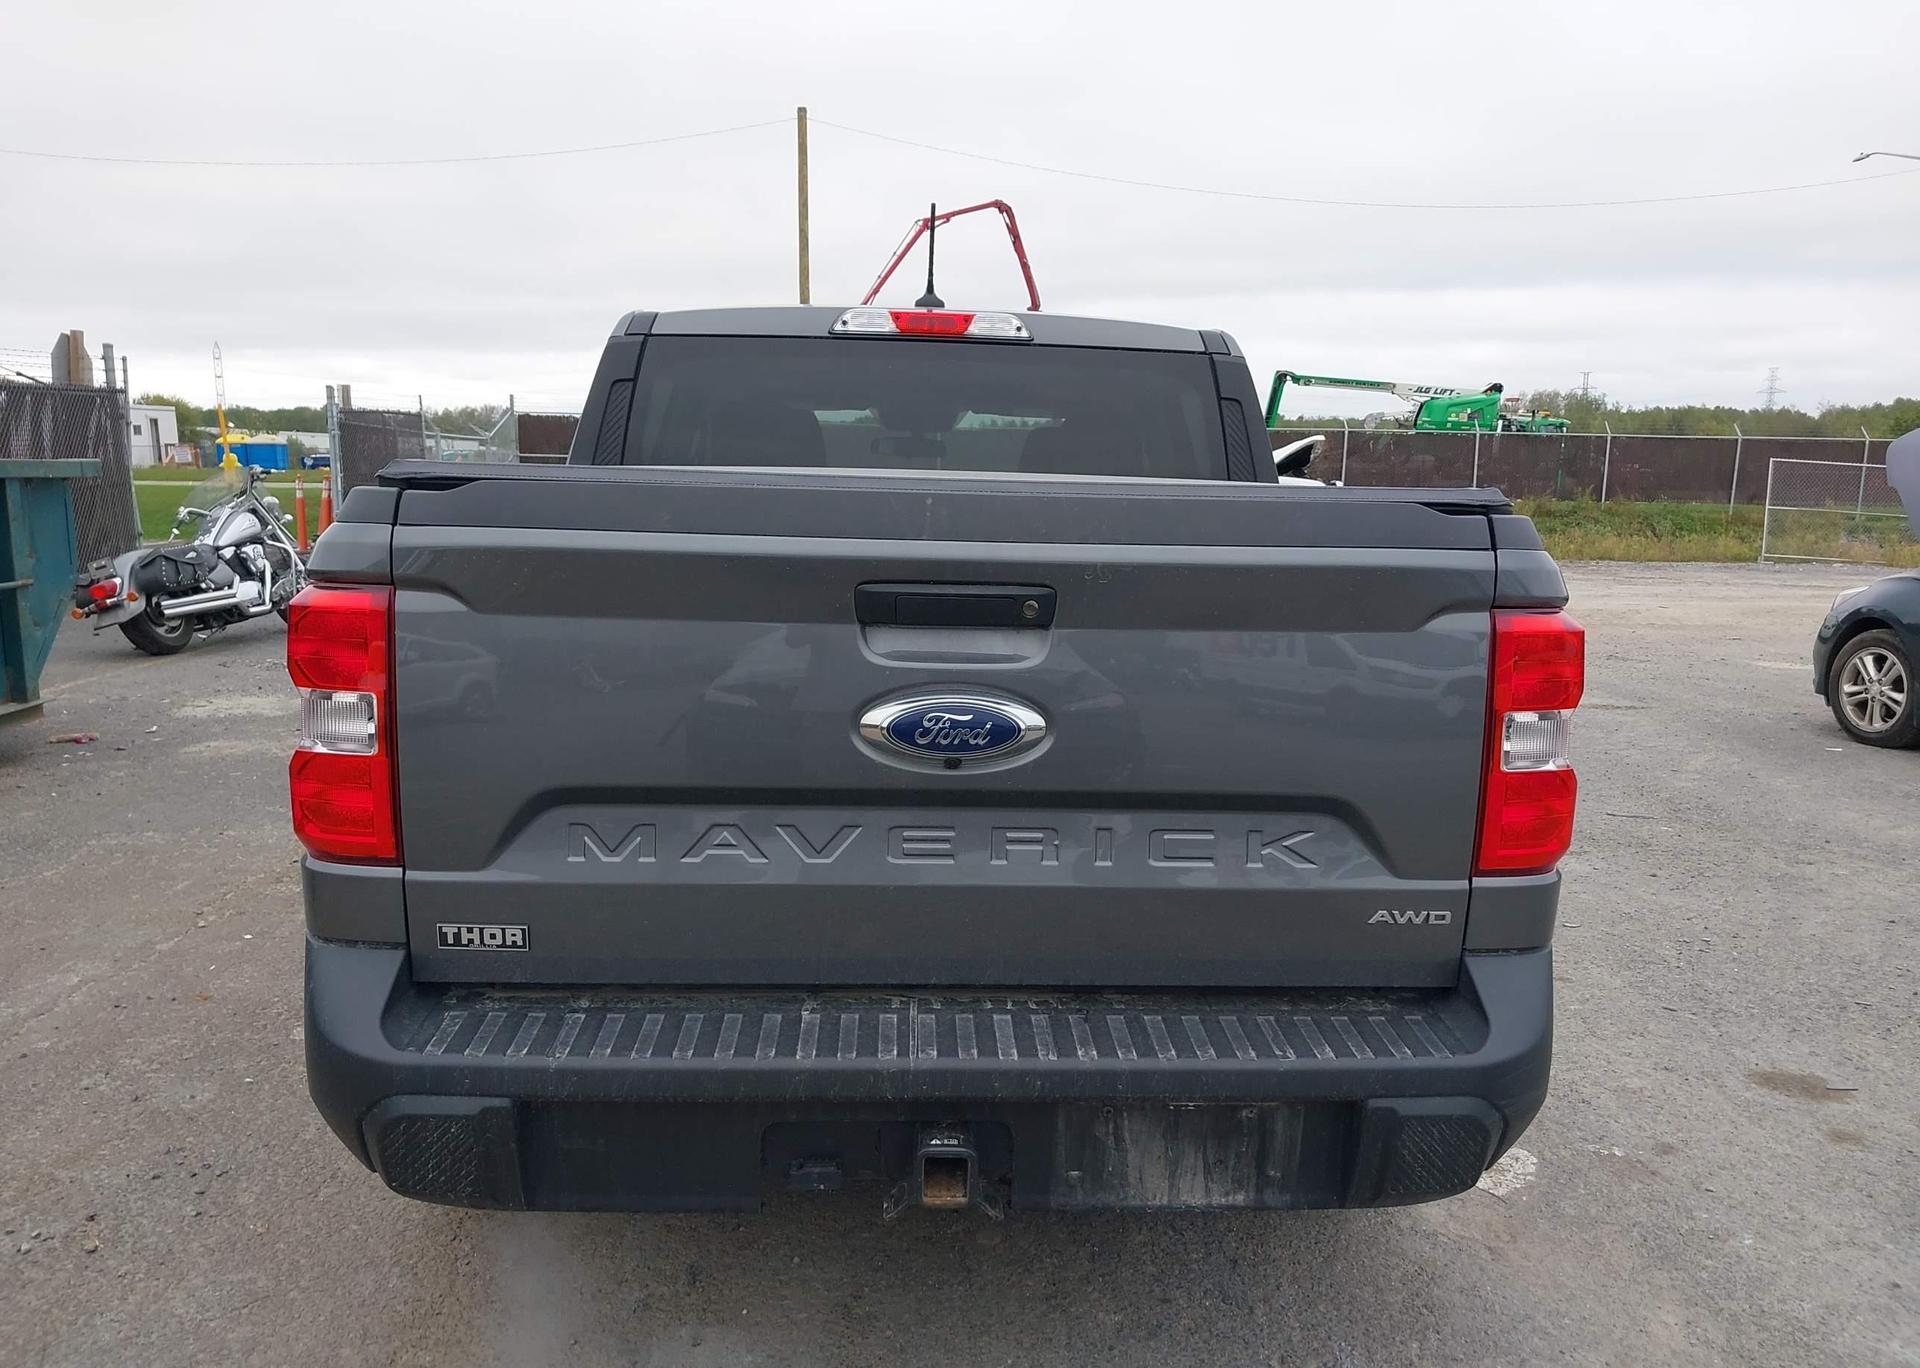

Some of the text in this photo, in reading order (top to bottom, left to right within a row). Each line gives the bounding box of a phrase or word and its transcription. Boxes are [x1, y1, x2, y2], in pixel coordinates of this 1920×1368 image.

[1413, 386, 1456, 396] JLG LIFT
[914, 712, 993, 746] Ford
[566, 822, 1319, 868] MAVERICK
[1367, 910, 1452, 925] AWD
[441, 926, 524, 946] THOR
